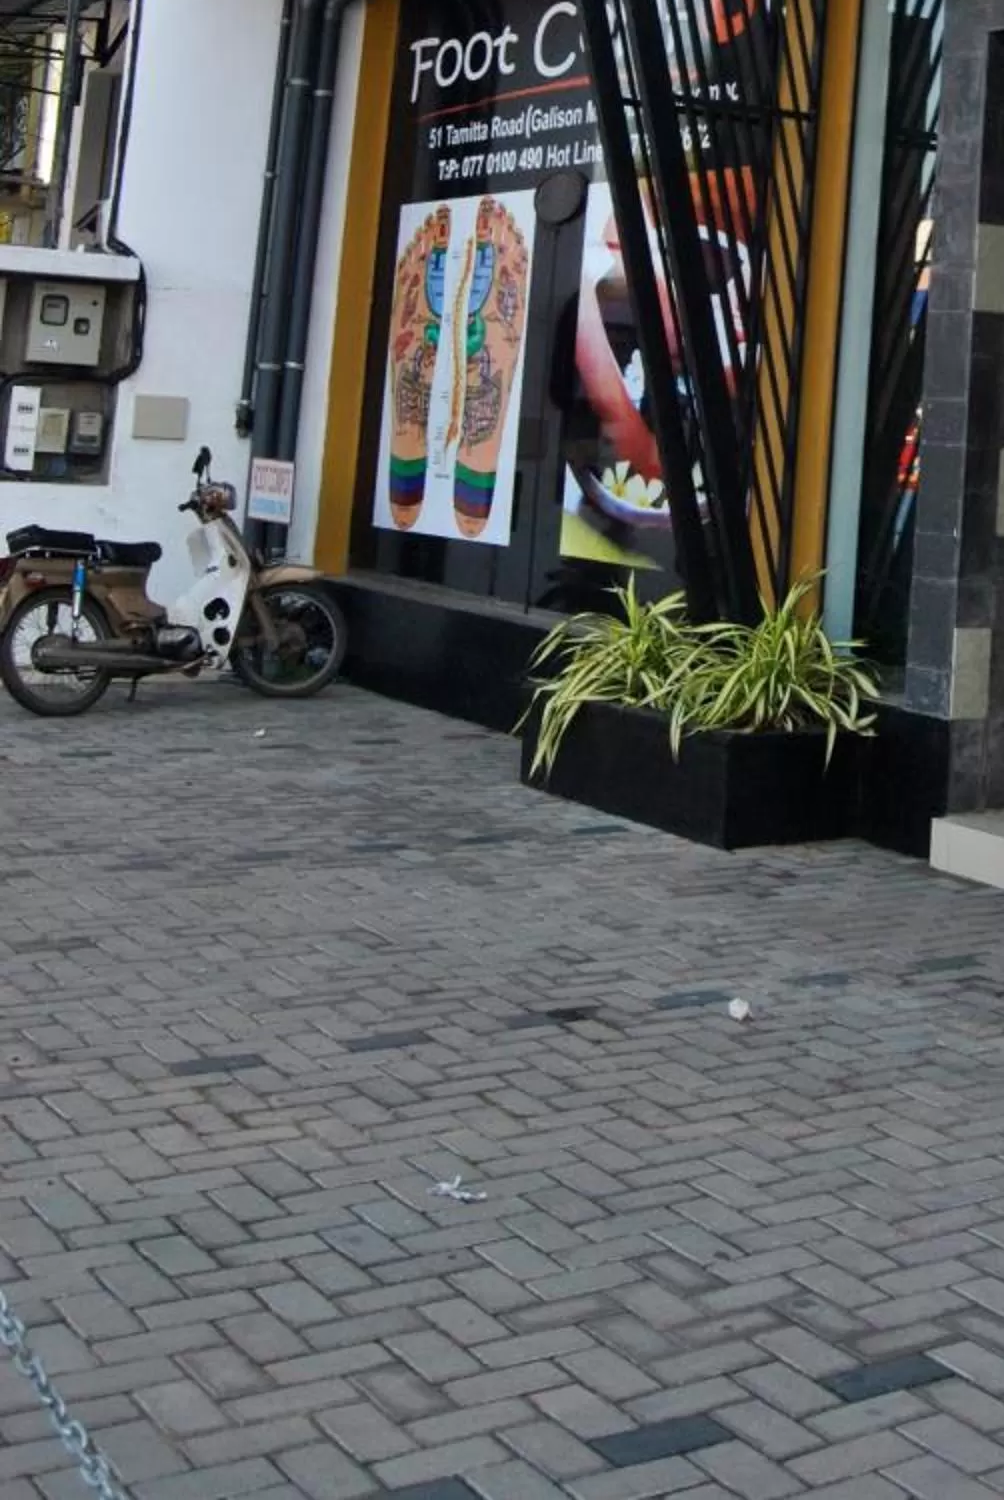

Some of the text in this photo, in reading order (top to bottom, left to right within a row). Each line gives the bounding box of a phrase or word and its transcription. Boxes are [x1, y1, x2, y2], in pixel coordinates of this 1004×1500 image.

[428, 126, 442, 149] 51
[461, 152, 485, 179] 077
[485, 149, 516, 175] 0100
[518, 145, 543, 170] 490
[545, 142, 571, 169] Hot
